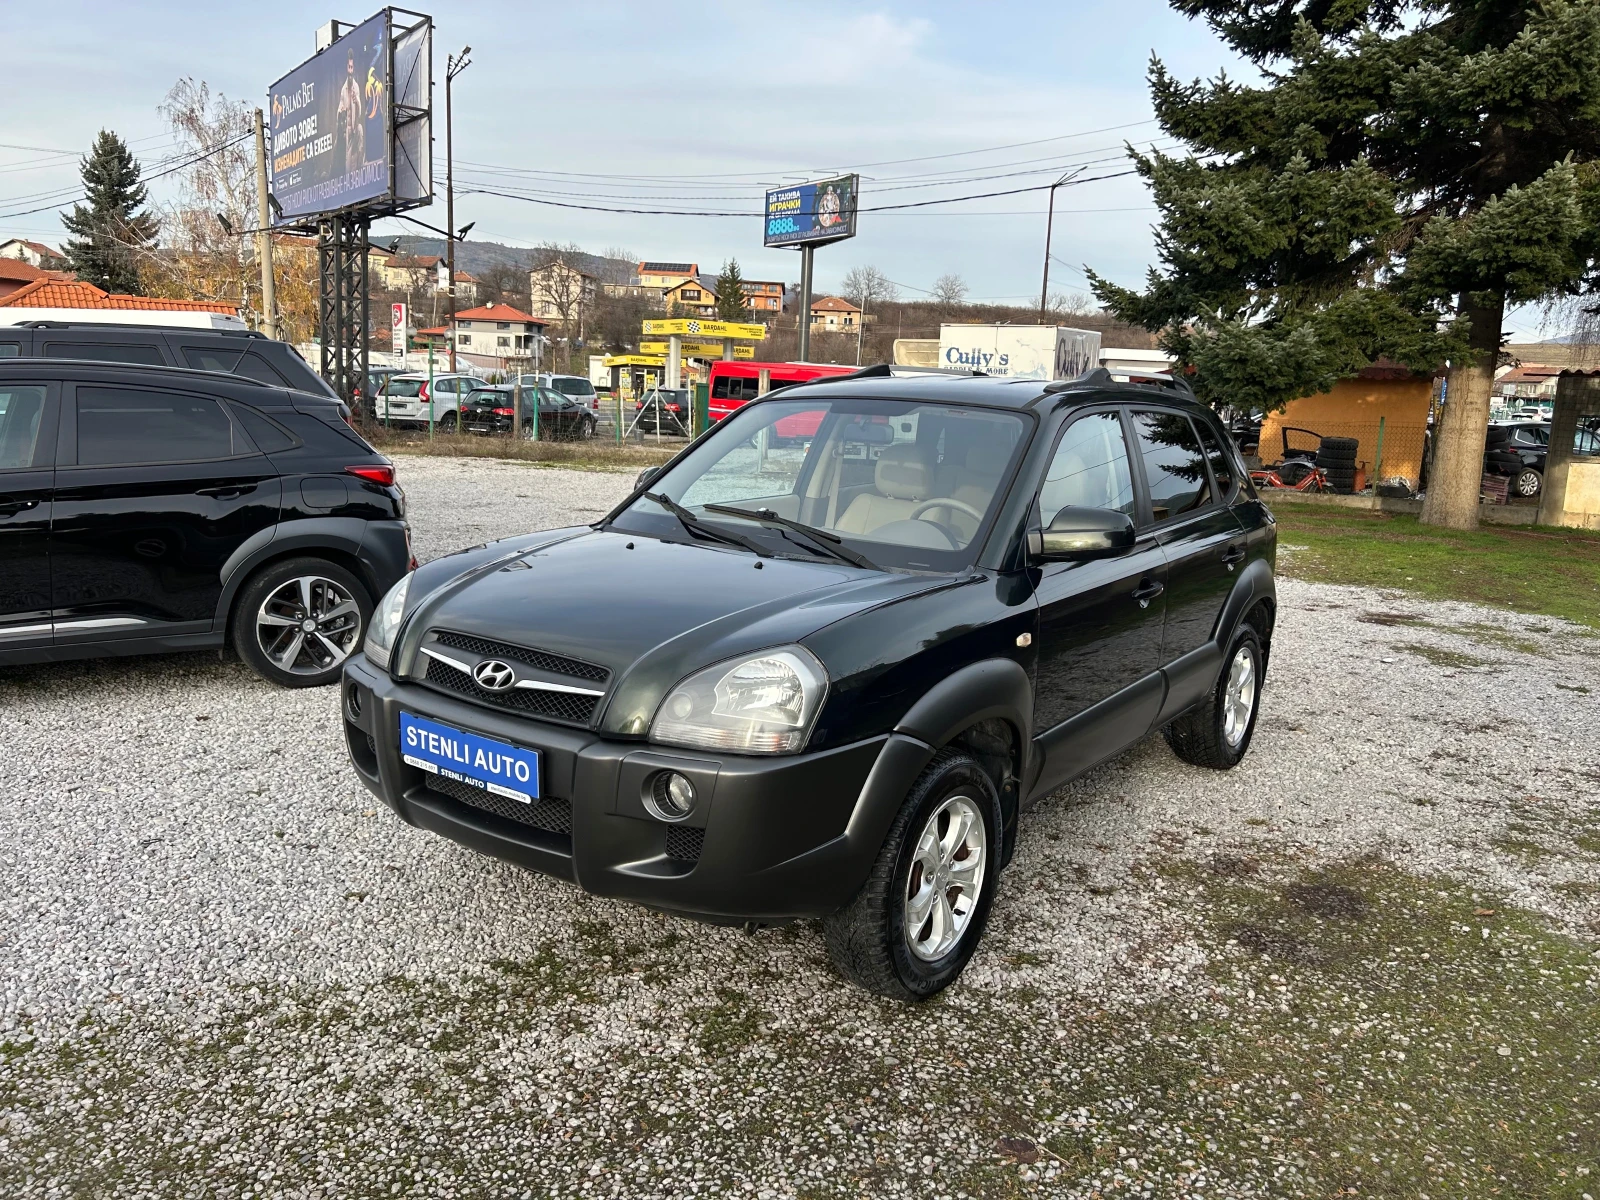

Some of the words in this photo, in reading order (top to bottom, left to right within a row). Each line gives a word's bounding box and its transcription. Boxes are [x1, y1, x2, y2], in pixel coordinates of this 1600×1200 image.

[282, 90, 302, 119] PALMS
[302, 82, 315, 108] BET
[274, 126, 298, 156] ДИВОТО
[299, 114, 317, 142] ЗОВЕ!
[769, 199, 801, 212] ИГРАЧКИ
[778, 190, 801, 201] ТАКИВА
[704, 324, 728, 332] BARDAHL
[406, 726, 469, 764] STENLI
[474, 748, 530, 782] AUTO
[440, 768, 463, 782] STENLI
[464, 776, 485, 788] AUTO
